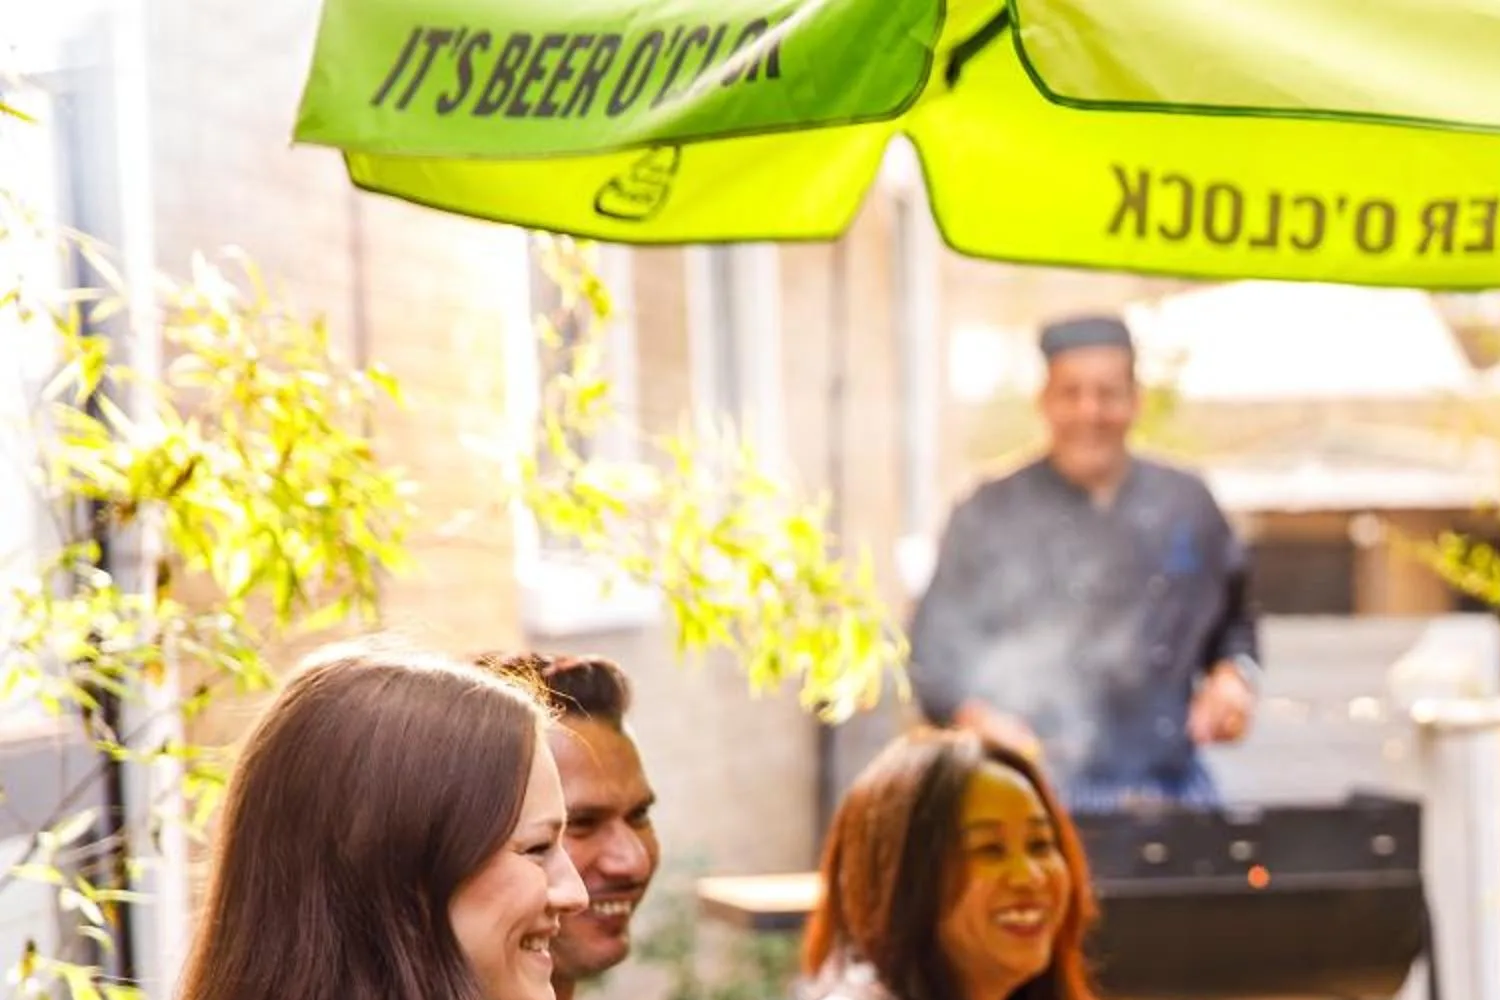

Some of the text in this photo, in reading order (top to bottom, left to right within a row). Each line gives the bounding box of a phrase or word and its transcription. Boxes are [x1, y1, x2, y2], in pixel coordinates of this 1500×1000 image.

[371, 16, 783, 119] IT'S BEER O'CLOK
